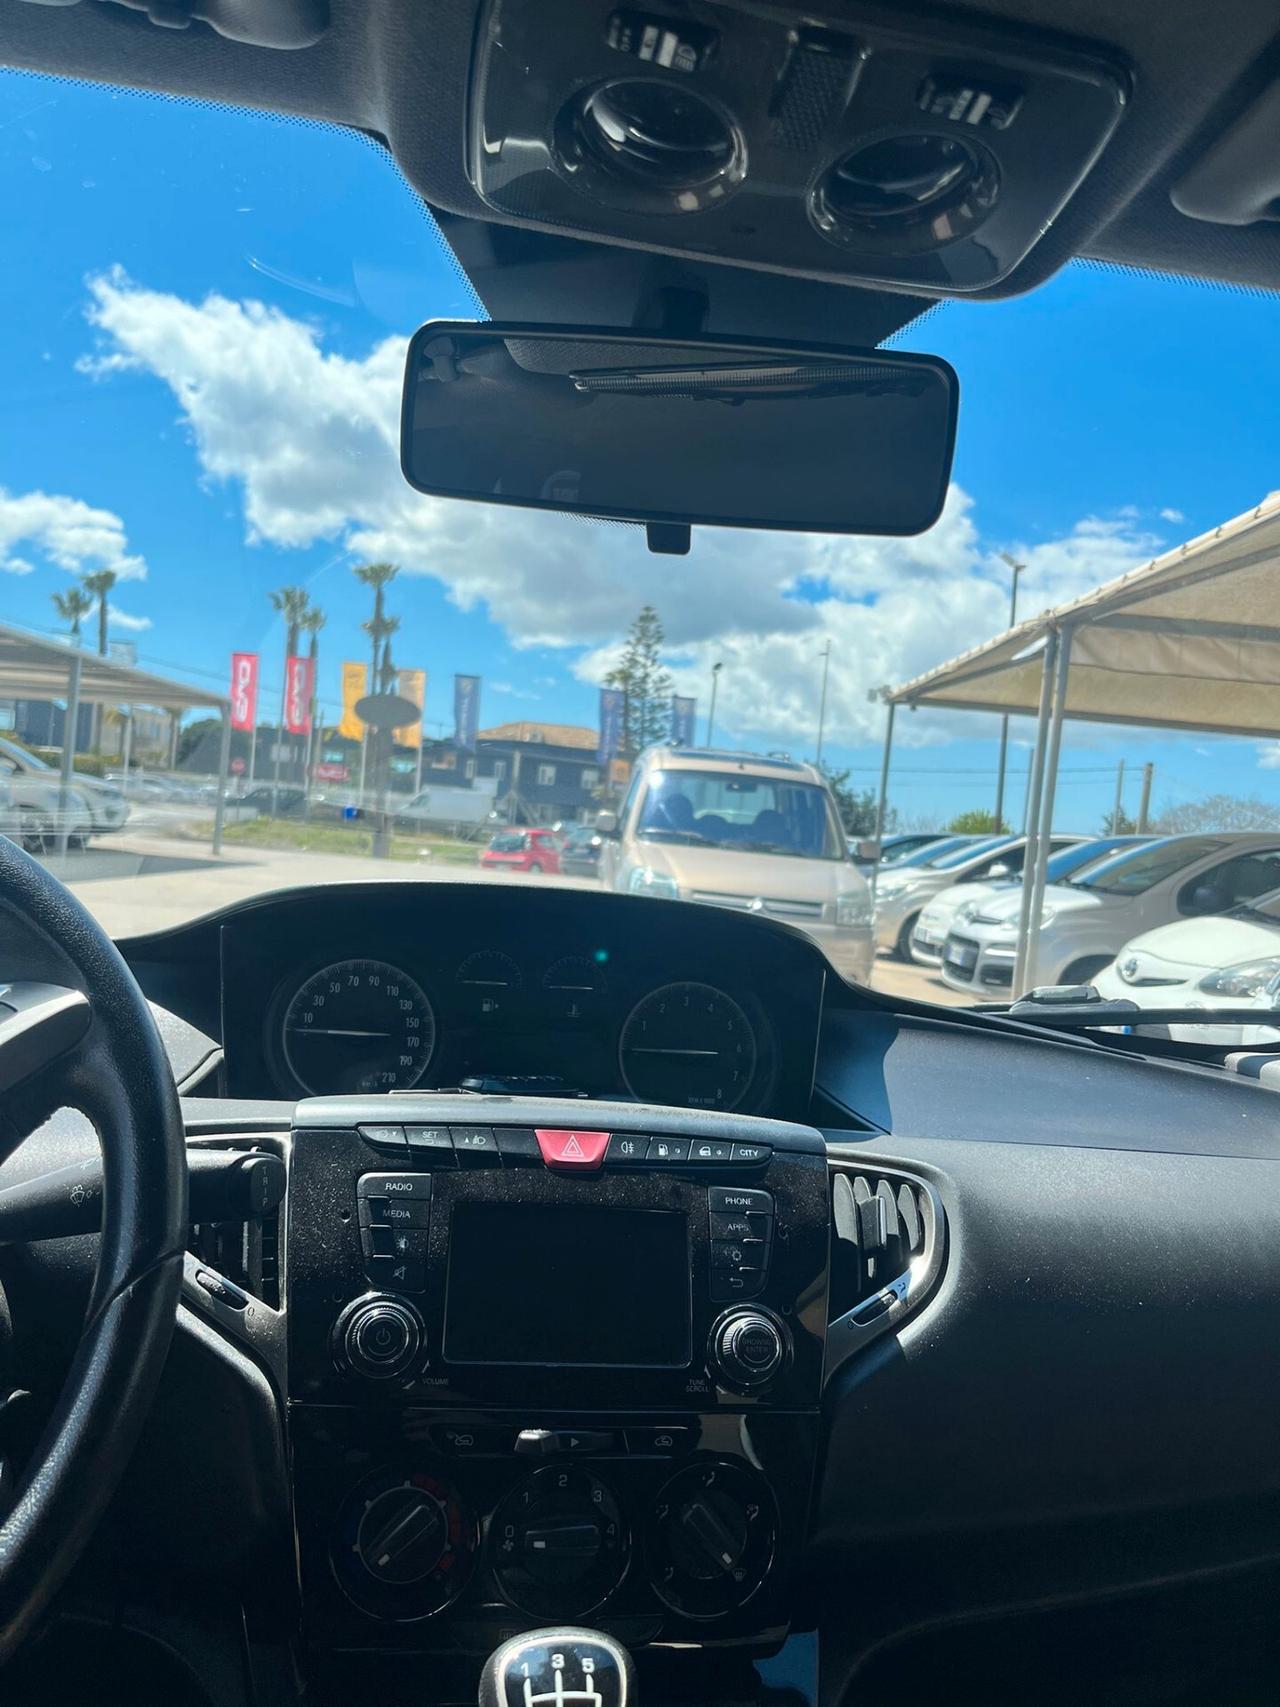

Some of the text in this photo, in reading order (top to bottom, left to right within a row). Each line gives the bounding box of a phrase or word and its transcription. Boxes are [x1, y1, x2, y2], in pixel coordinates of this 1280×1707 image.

[348, 976, 359, 985] 70
[369, 976, 379, 986] 90
[329, 983, 340, 993] 50
[386, 986, 399, 996] 110
[313, 996, 325, 1006] 30
[400, 1000, 413, 1010] 130
[683, 997, 689, 1007] 3
[659, 1003, 666, 1013] 2
[304, 1013, 313, 1023] 10
[406, 1018, 419, 1028] 150
[408, 1036, 420, 1048] 170
[400, 1055, 413, 1066] 190
[422, 1131, 439, 1139] SET
[739, 1148, 759, 1157] CITY
[261, 1166, 270, 1208] TRIP
[385, 1182, 413, 1191] RADIO
[725, 1196, 753, 1206] PHONE
[382, 1209, 412, 1219] MEDIA
[727, 1223, 751, 1232] APPS
[558, 1474, 568, 1487] 2
[522, 1491, 530, 1504] 1
[593, 1489, 603, 1502] 3
[504, 1525, 514, 1539] 0
[606, 1523, 616, 1536] 4
[551, 1653, 564, 1668] 3
[581, 1658, 595, 1673] 5
[521, 1662, 530, 1677] 1
